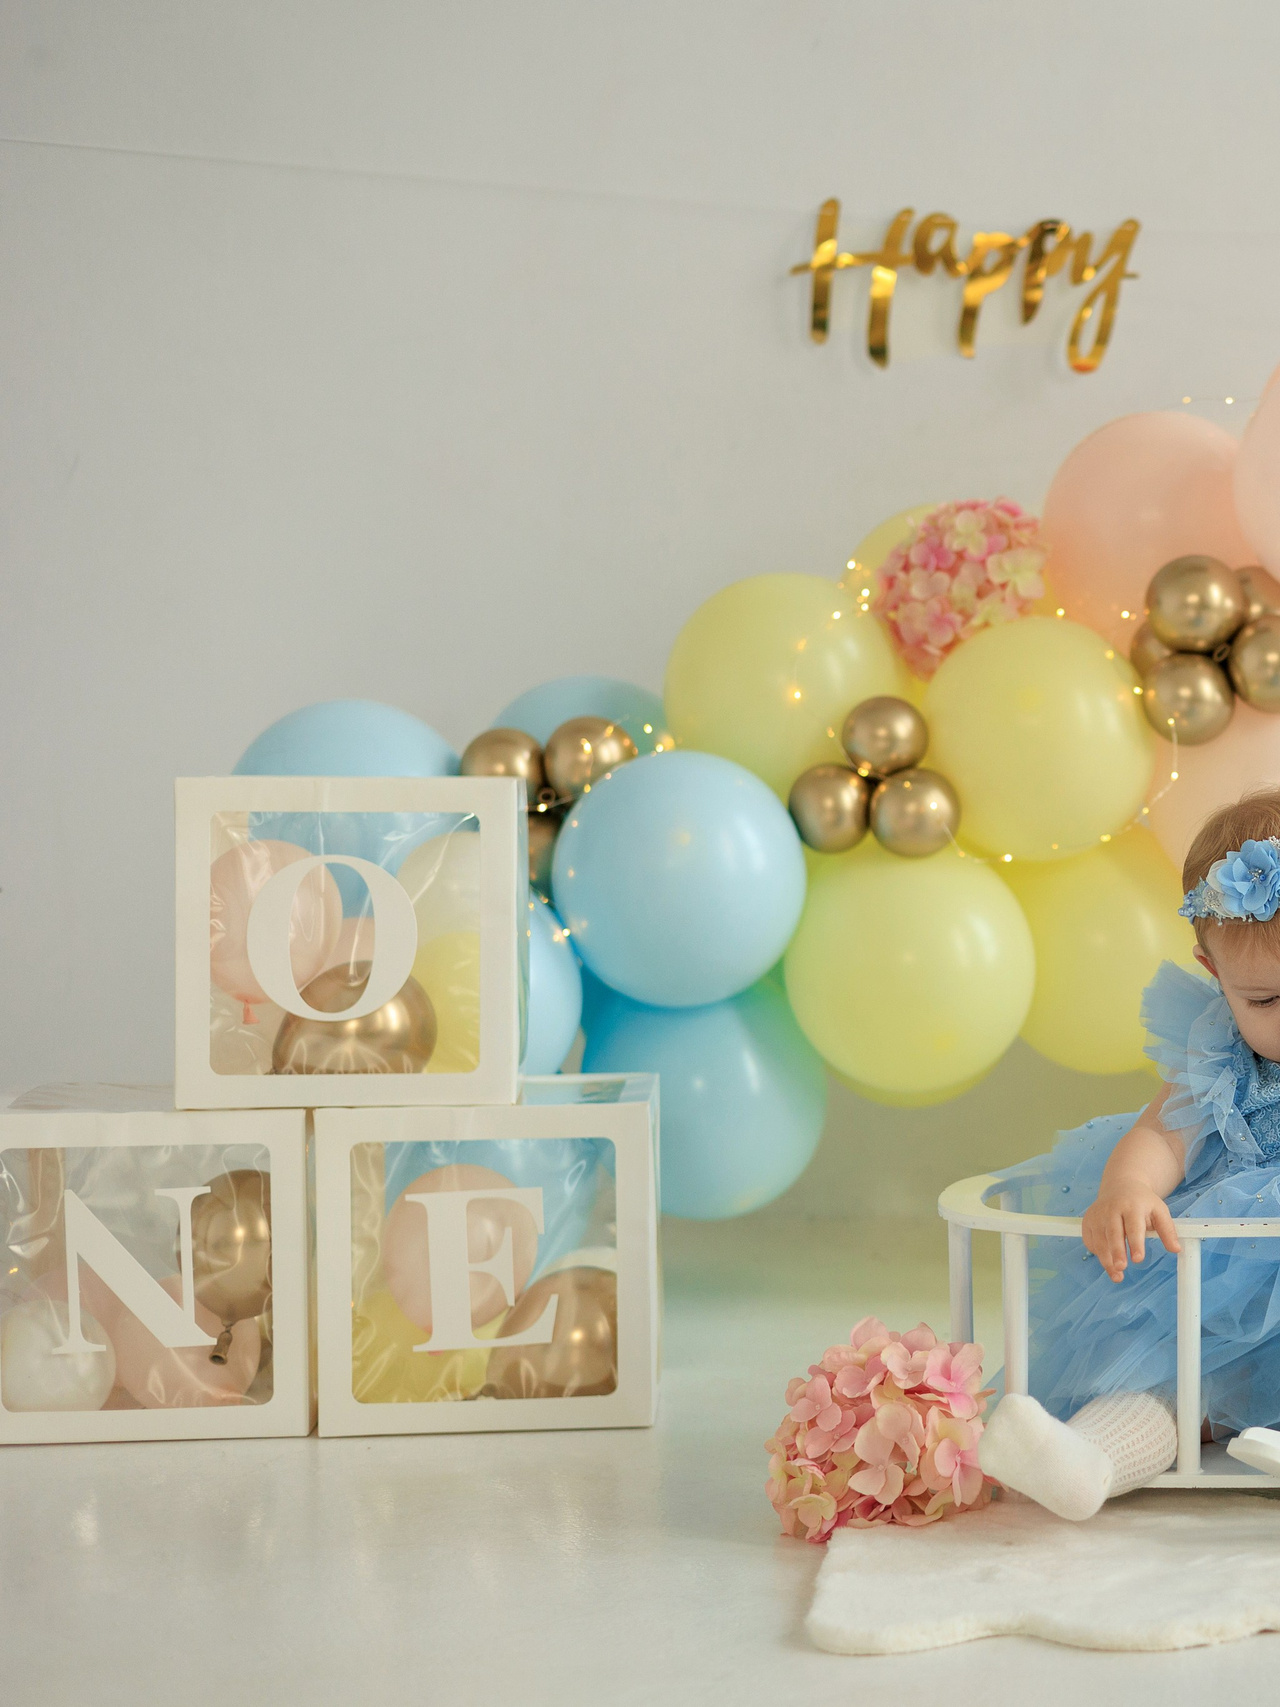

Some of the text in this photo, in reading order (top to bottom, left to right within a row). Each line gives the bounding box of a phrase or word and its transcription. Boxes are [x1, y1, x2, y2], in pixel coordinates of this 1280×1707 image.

[790, 197, 1139, 374] Happy
[246, 854, 418, 1022] O
[51, 1186, 217, 1356] N
[405, 1187, 559, 1353] E
